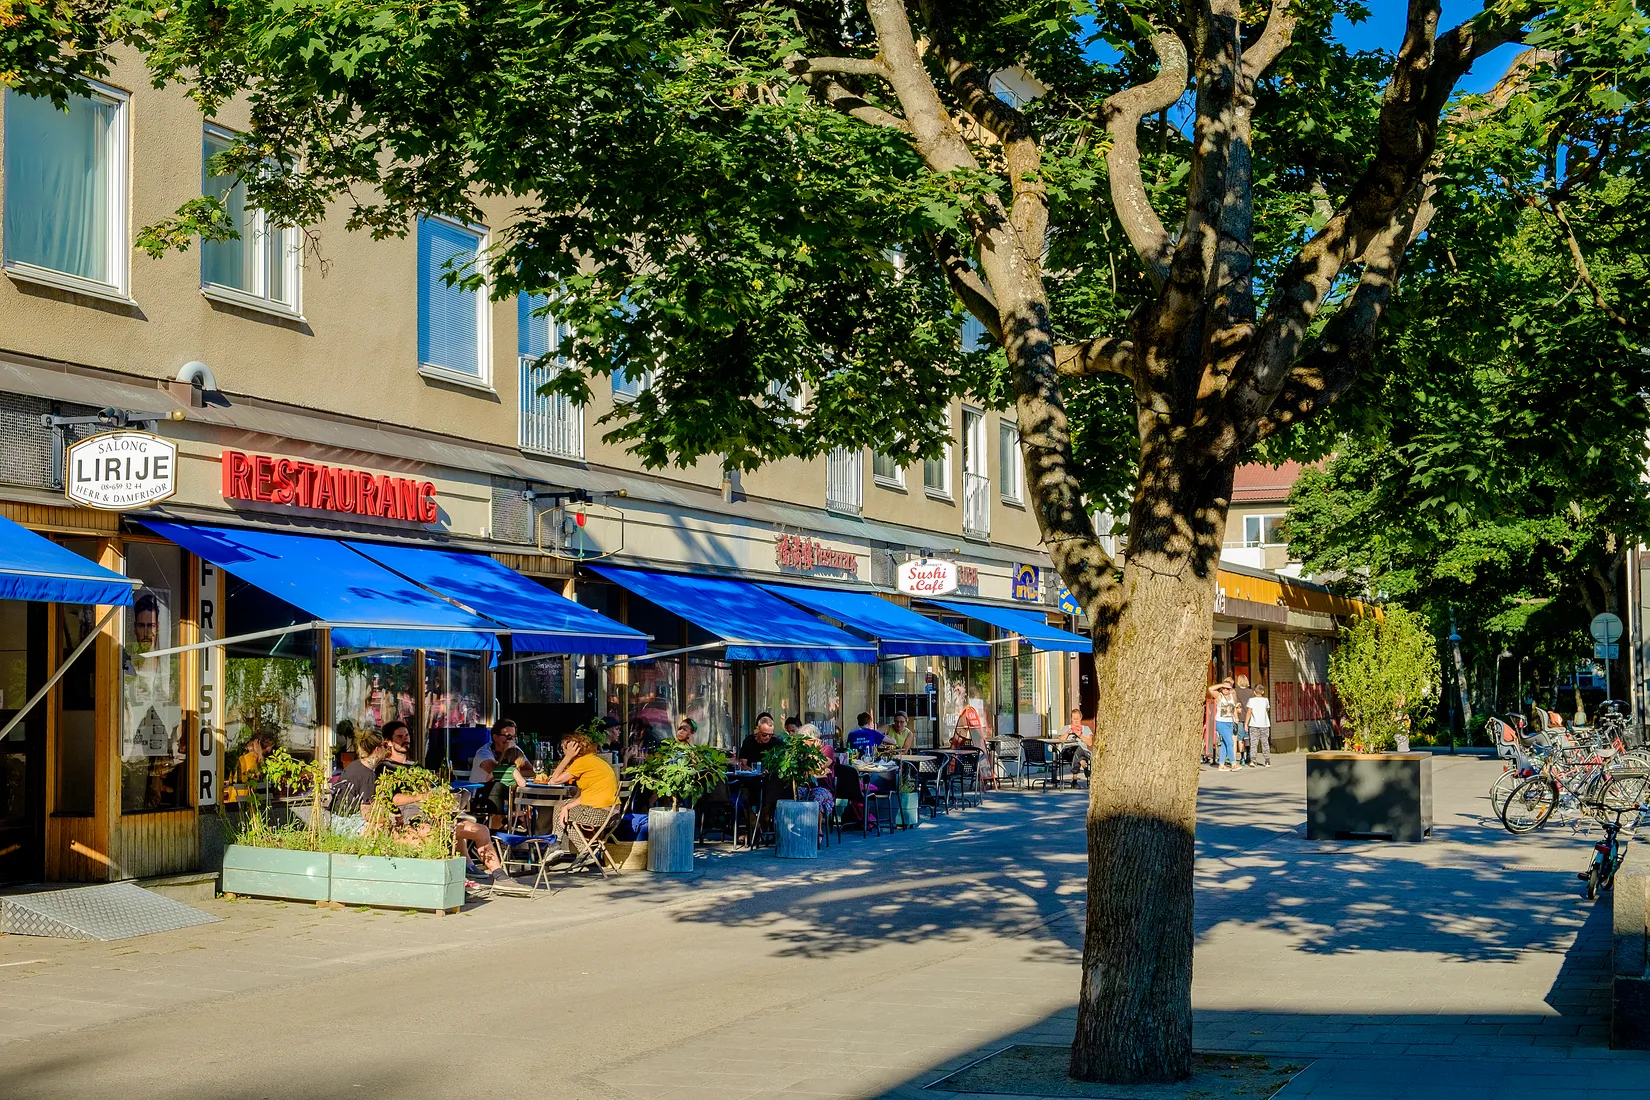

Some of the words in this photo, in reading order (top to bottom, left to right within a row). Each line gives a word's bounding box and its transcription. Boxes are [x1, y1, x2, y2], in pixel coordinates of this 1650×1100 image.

[98, 440, 147, 454] SALONG
[77, 456, 169, 482] LIRIJE
[76, 484, 100, 500] HERR
[103, 494, 109, 502] &
[113, 482, 167, 503] DAMFRISÖR
[221, 450, 437, 523] RESTAURANG
[908, 567, 947, 580] Sushi
[916, 580, 944, 593] Café
[200, 562, 213, 799] FRISÖR
